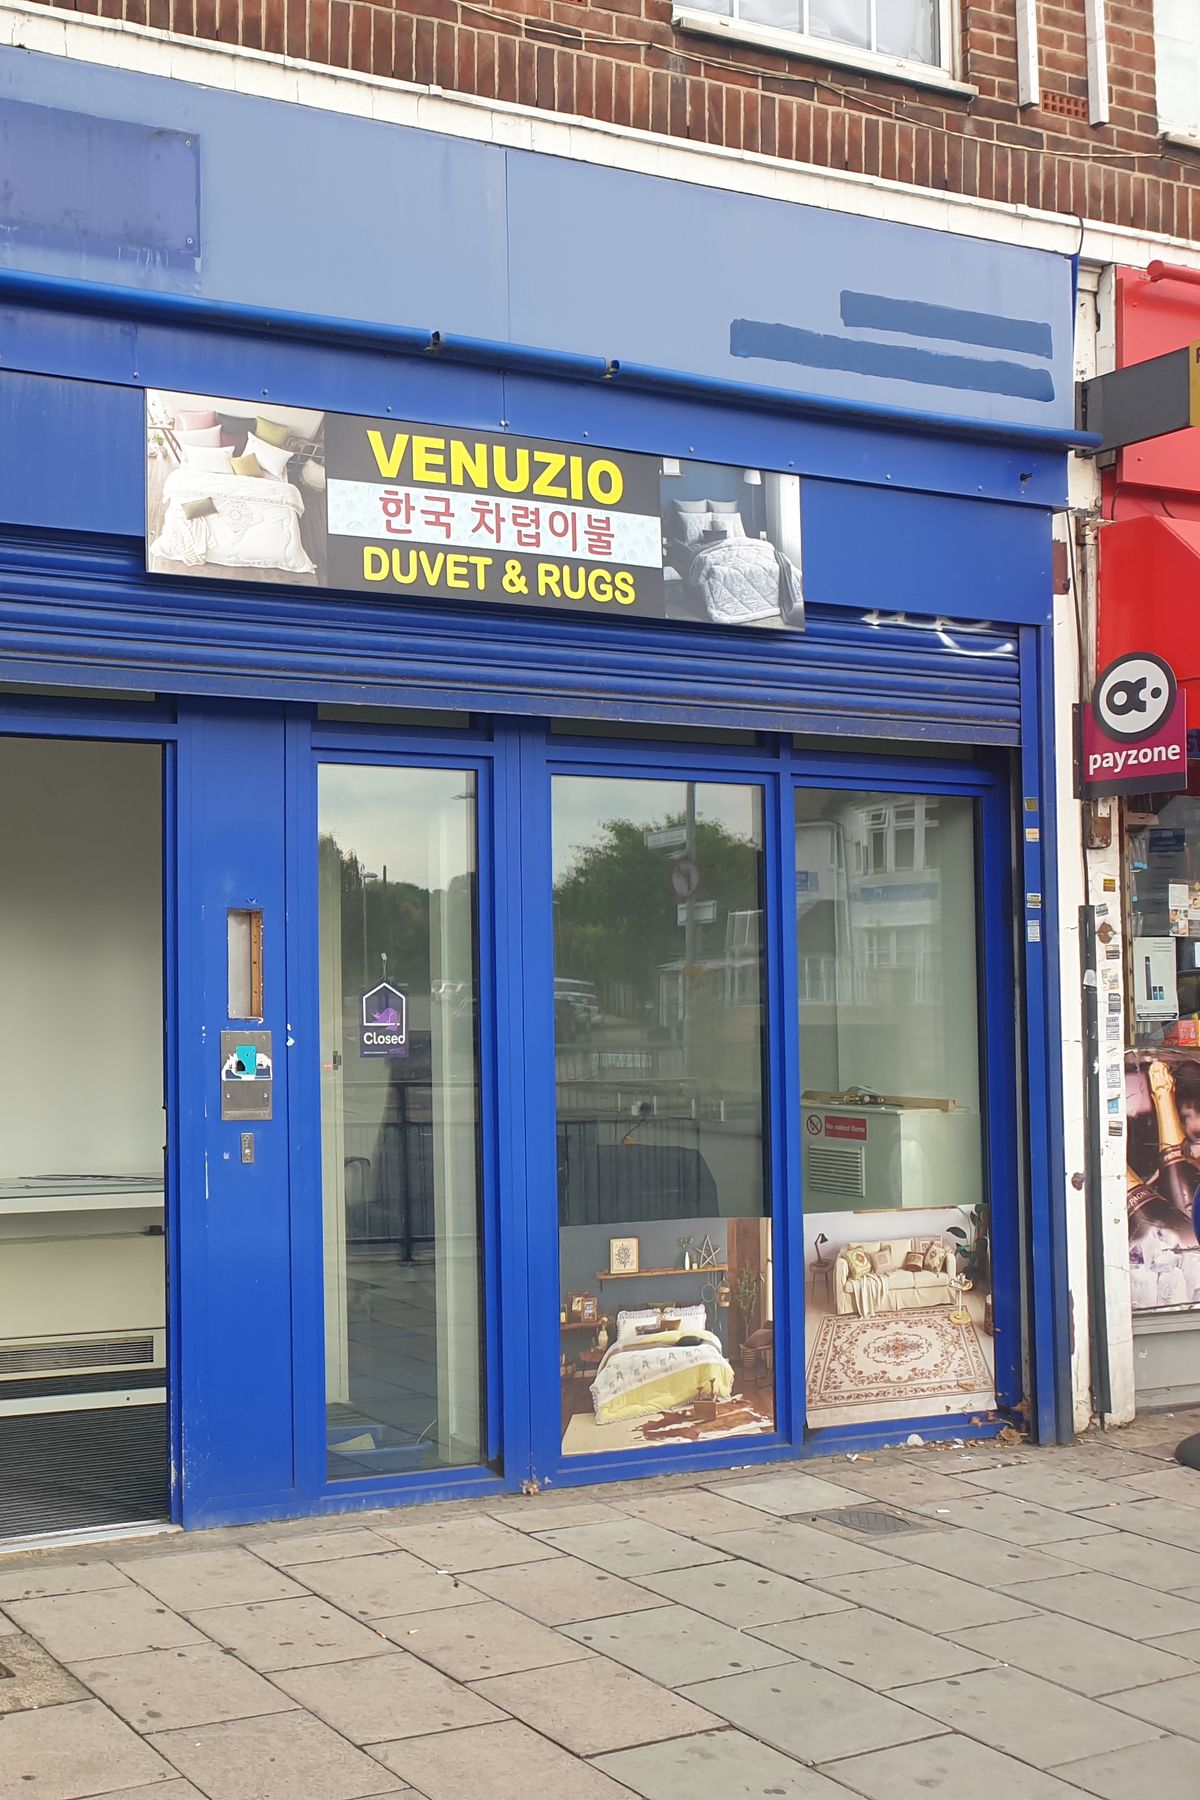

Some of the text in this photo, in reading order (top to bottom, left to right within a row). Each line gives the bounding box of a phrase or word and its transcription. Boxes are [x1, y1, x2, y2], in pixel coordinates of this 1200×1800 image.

[366, 429, 624, 505] VENUZIO
[379, 489, 615, 556] 한국 차렵이불
[363, 545, 636, 606] DUVET & RUGS
[1089, 743, 1181, 775] payzone
[363, 1031, 406, 1045] Closed
